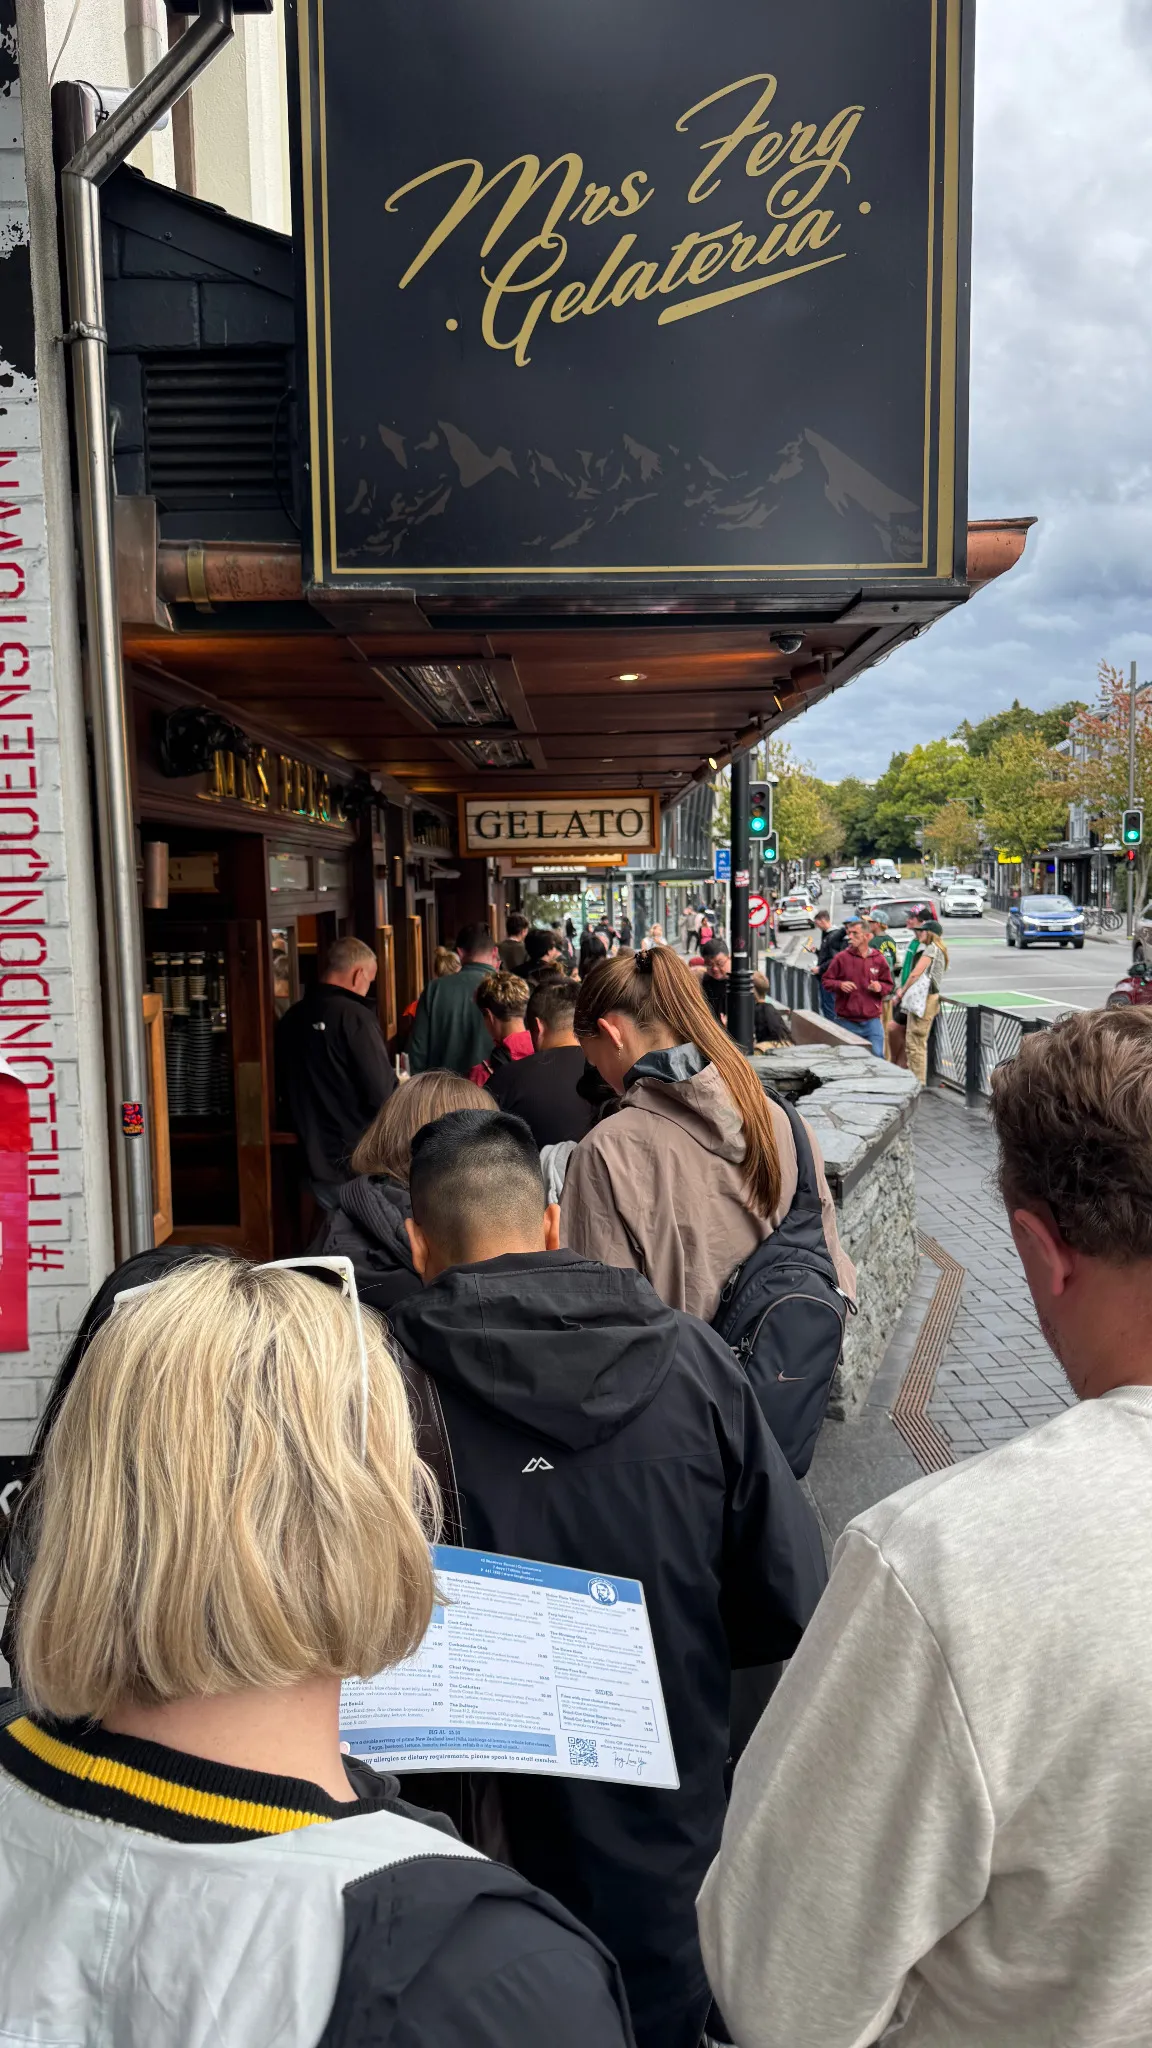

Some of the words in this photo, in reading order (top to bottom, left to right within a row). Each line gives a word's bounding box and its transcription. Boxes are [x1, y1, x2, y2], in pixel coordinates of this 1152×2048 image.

[385, 152, 654, 289] Mrs
[675, 72, 865, 217] Ferg
[480, 200, 842, 367] Gelateria
[475, 808, 643, 839] GELATO
[595, 1689, 614, 1697] SIDES
